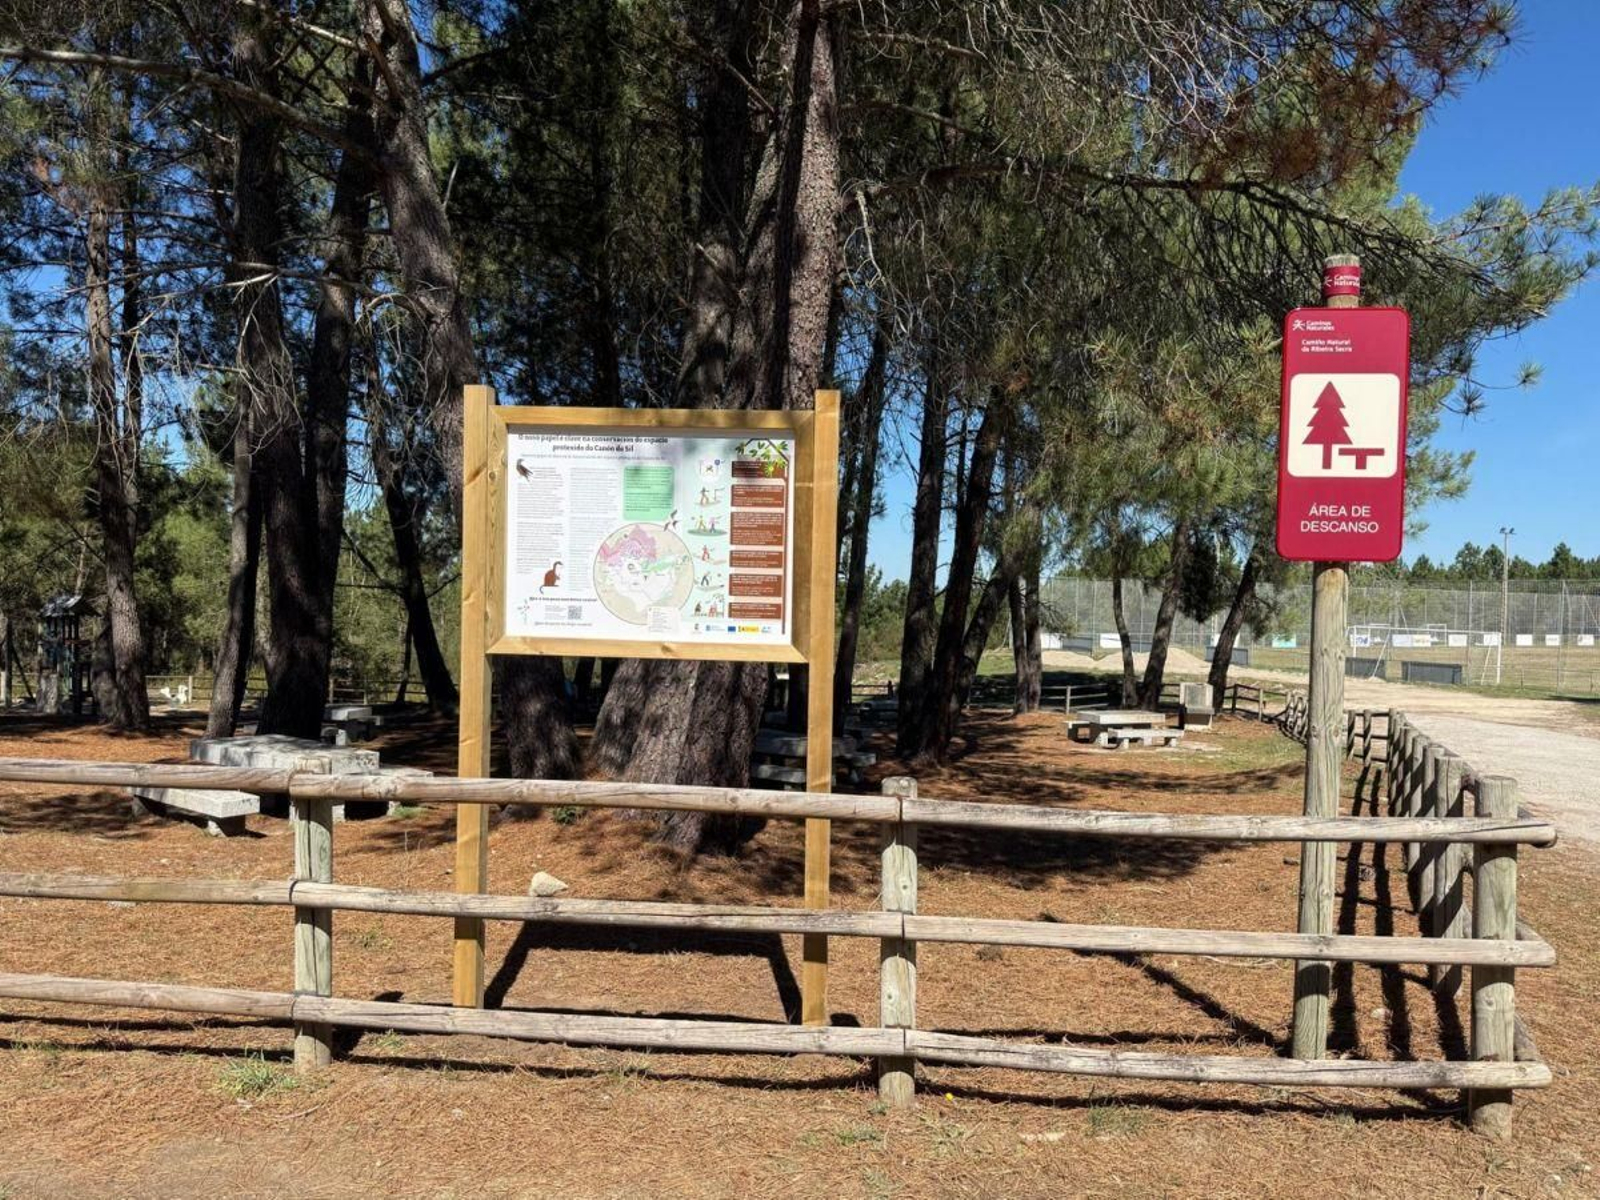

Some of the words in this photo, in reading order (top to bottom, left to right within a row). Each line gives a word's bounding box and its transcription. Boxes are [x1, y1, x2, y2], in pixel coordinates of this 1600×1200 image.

[1301, 338, 1325, 346] Camiño
[1327, 338, 1351, 346] Natural
[1309, 502, 1348, 517] ÁREA
[1351, 505, 1371, 517] DE
[1300, 520, 1379, 533] DESCANSO
